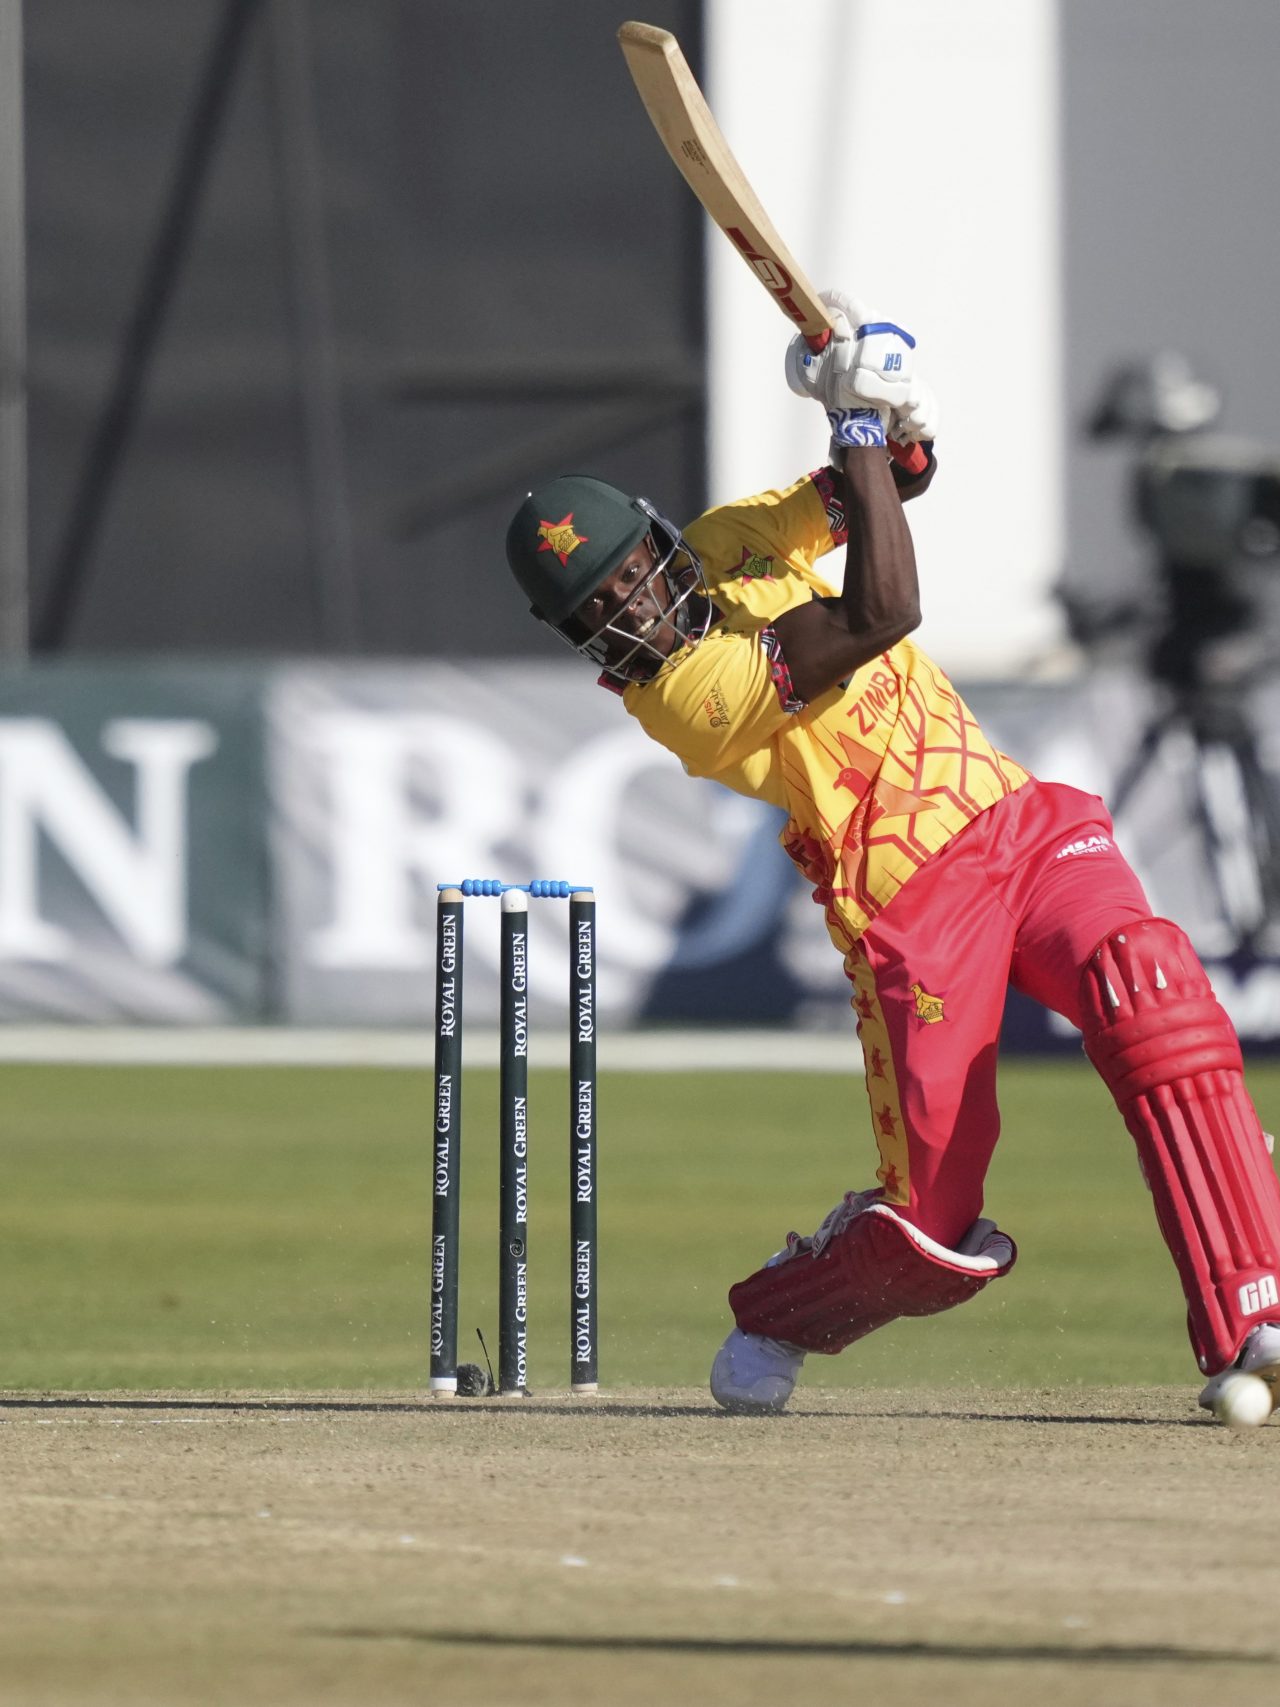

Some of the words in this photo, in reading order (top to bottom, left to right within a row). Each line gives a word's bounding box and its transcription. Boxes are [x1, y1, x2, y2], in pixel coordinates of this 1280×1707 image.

[846, 670, 899, 737] ZIMB
[441, 914, 455, 973] GREEN
[512, 933, 525, 992] GREEN
[577, 920, 591, 979] GREEN
[441, 977, 455, 1037] ROYAL
[514, 996, 527, 1057] ROYAL
[578, 983, 593, 1043] ROYAL
[436, 1074, 451, 1133] GREEN
[513, 1096, 527, 1158] GREEN
[576, 1080, 592, 1139] GREEN
[435, 1137, 450, 1197] ROYAL
[516, 1162, 528, 1224] ROYAL
[576, 1143, 592, 1203] ROYAL
[432, 1235, 446, 1293] GREEN
[515, 1263, 528, 1322] GREEN
[575, 1240, 590, 1299] GREEN
[1238, 1275, 1280, 1316] GA
[430, 1295, 443, 1357] ROYAL
[576, 1303, 591, 1363] ROYAL
[516, 1326, 528, 1387] ROYAL
